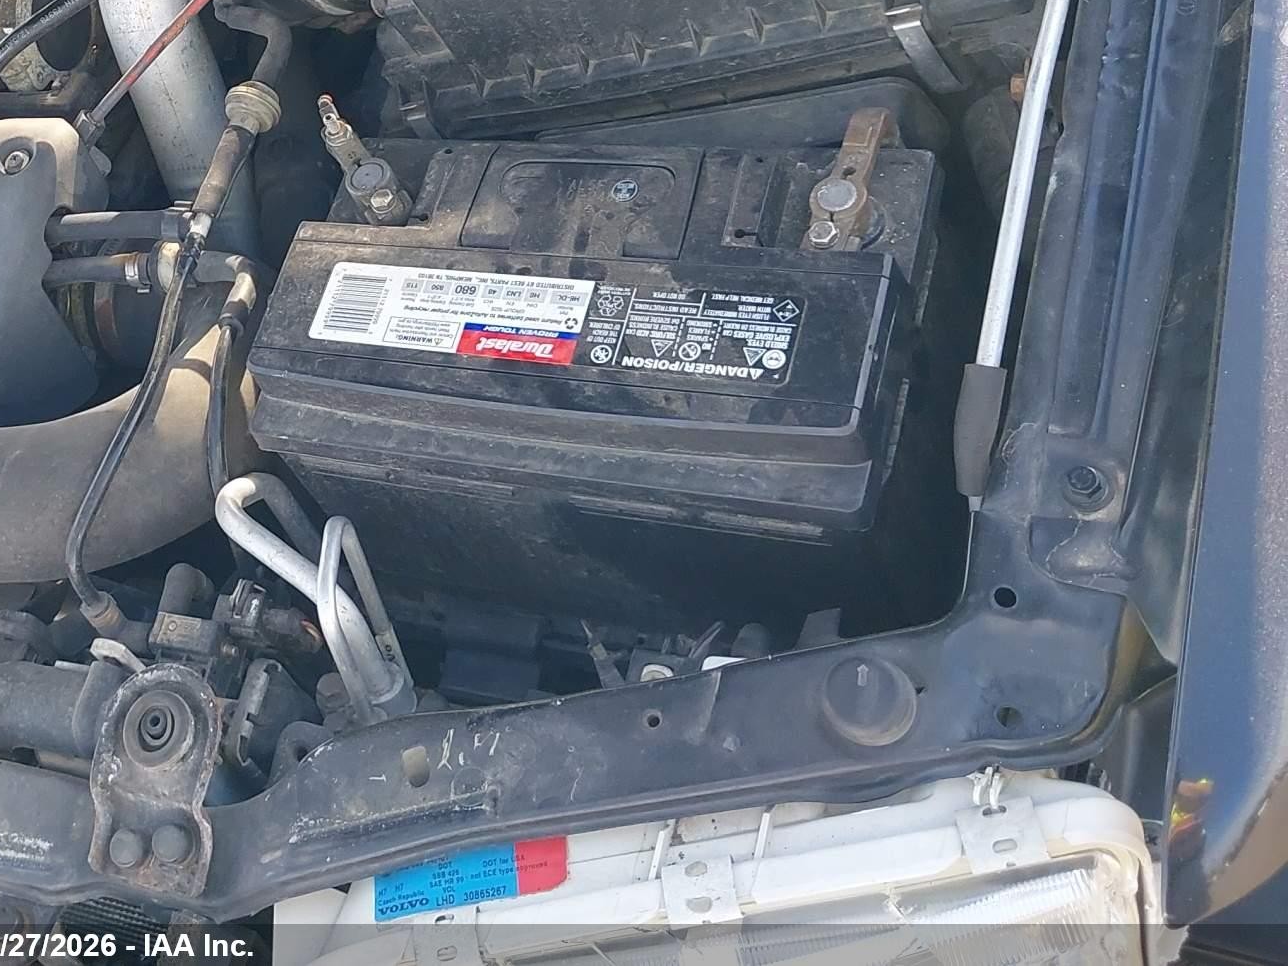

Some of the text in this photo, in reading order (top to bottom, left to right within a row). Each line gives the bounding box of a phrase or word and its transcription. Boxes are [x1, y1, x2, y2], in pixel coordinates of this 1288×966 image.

[454, 284, 478, 296] 680
[506, 289, 522, 298] LN3
[529, 292, 541, 300] H6
[679, 306, 698, 315] READ
[482, 325, 560, 339] PROVEN TOUGH
[396, 334, 434, 344] WARNING:
[754, 333, 791, 343] EXPLOSIVE
[476, 337, 554, 358] Duralast
[701, 342, 712, 351] NO
[765, 340, 789, 350] SHIELD
[621, 355, 749, 378] DANGER/POISON
[482, 858, 497, 868] DOT
[499, 866, 514, 877] type
[429, 879, 443, 888] SAE
[377, 885, 507, 916] VOLVO LHD 30865267
